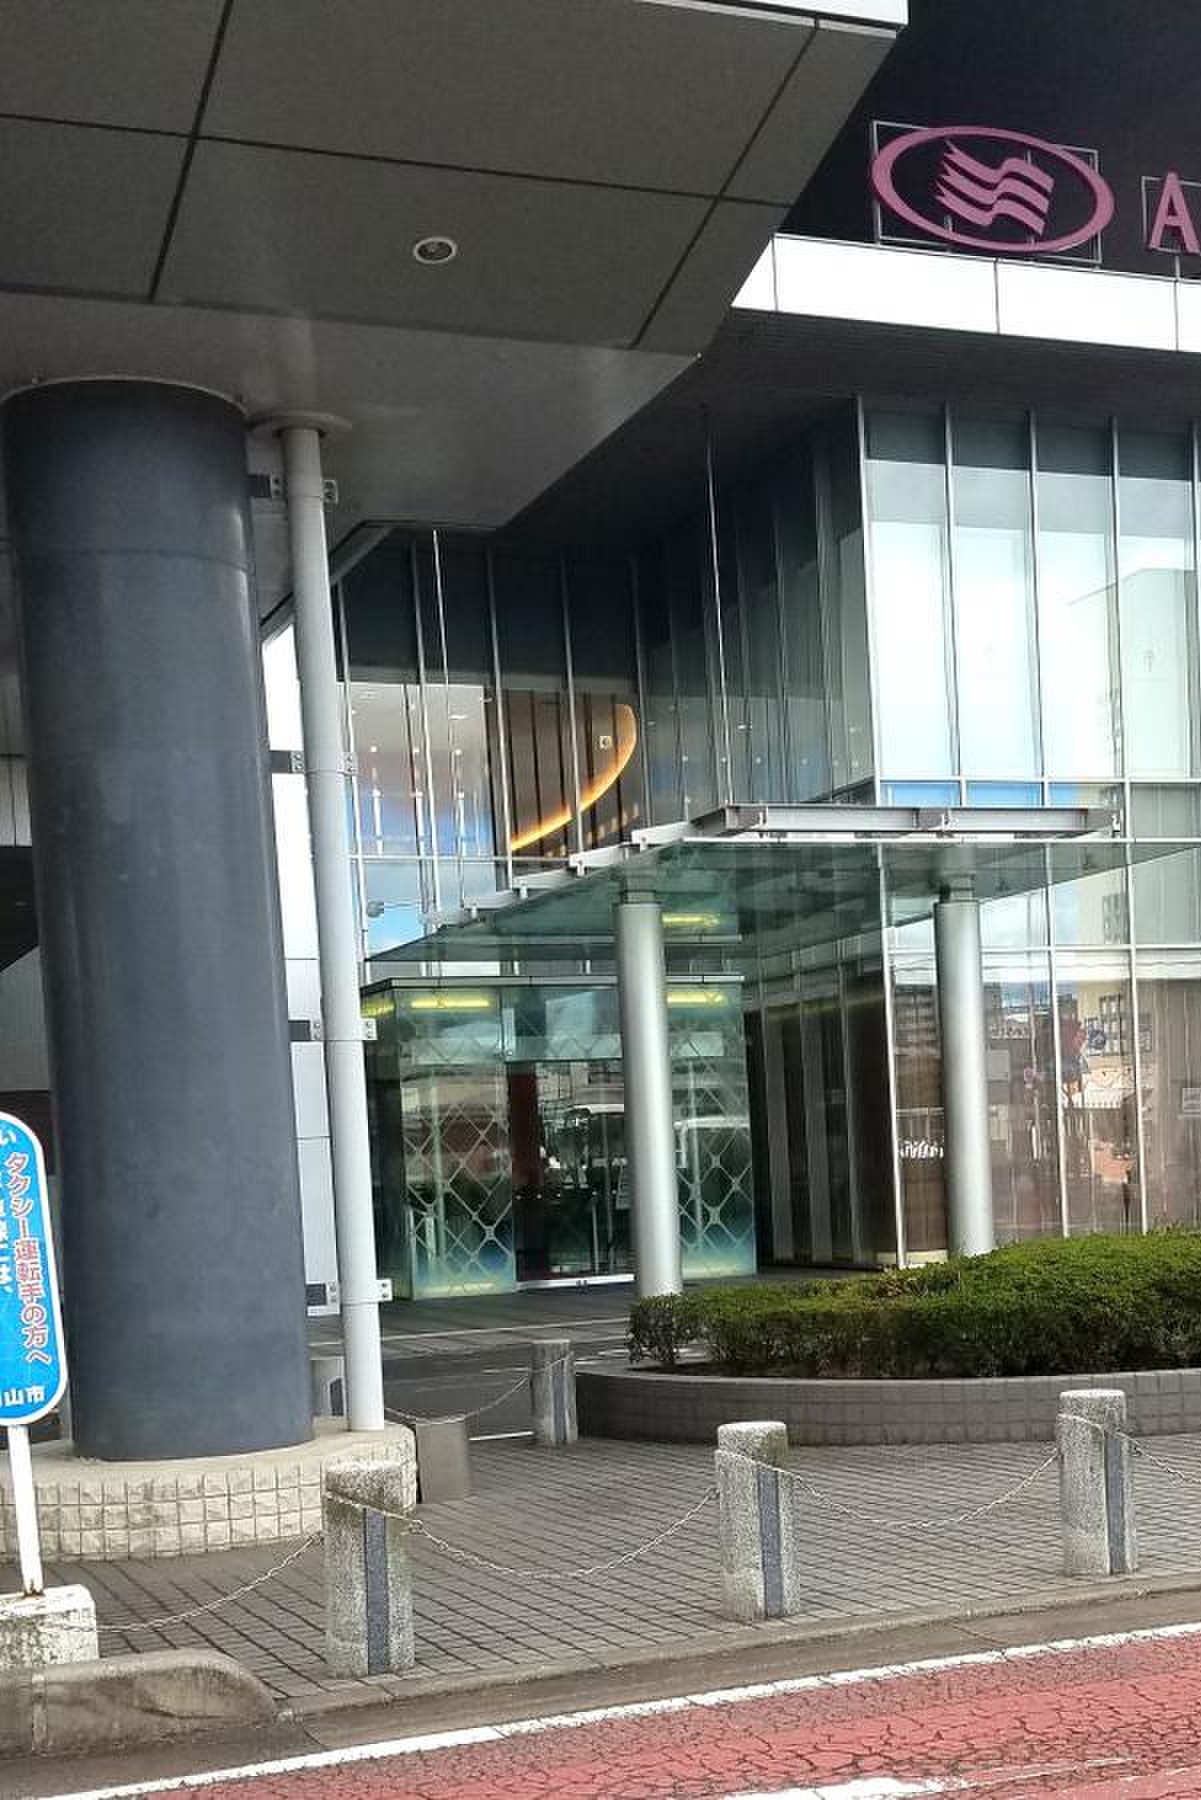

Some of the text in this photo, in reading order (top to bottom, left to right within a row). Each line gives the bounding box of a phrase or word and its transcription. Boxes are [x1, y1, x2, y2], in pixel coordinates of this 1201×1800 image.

[4, 1151, 52, 1366] タクシー運転手の方へ
[0, 1385, 46, 1409] 山市
